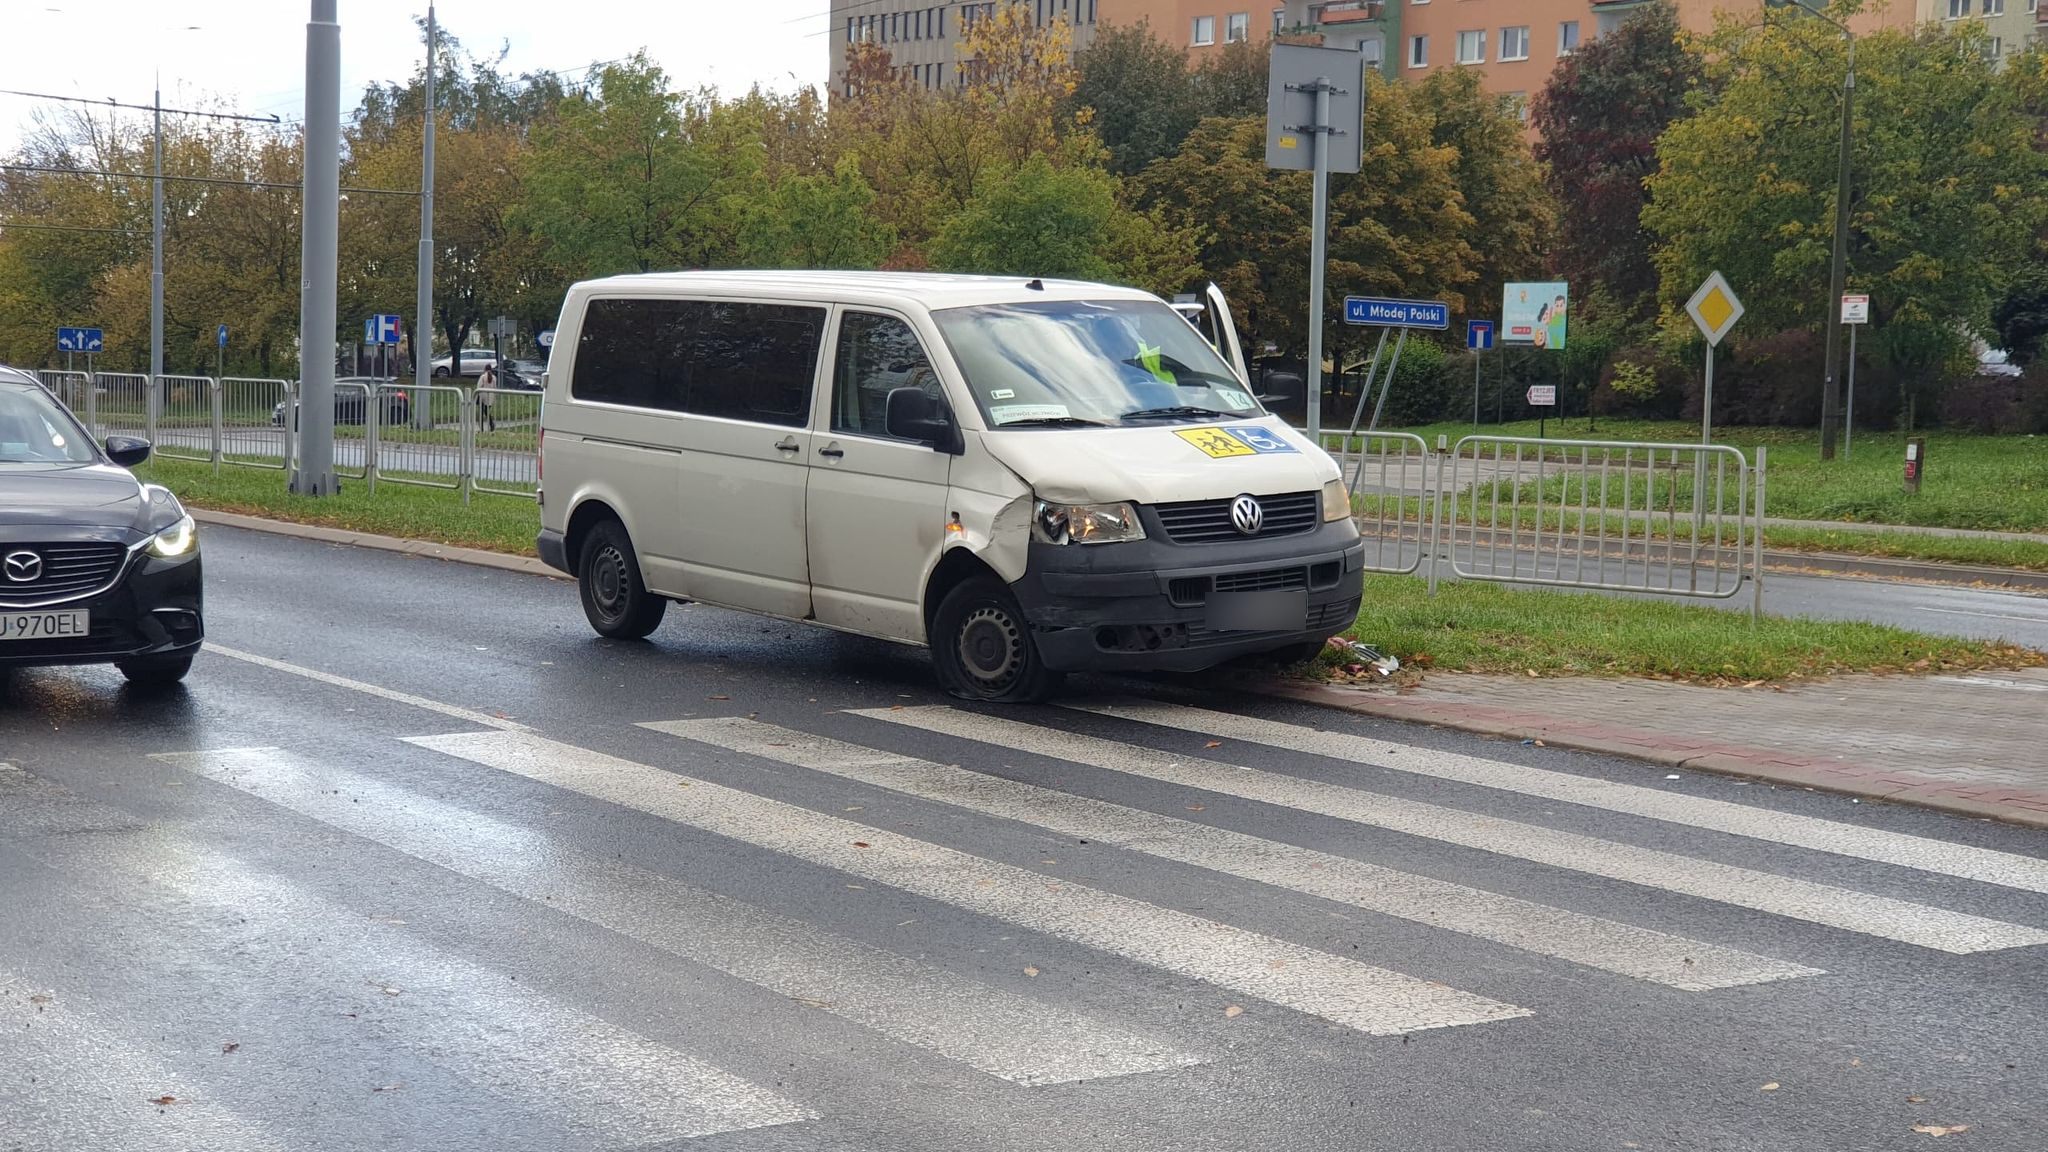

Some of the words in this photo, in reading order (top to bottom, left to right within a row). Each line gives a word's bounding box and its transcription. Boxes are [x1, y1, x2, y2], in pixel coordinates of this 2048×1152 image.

[1353, 304, 1365, 317] ul.
[1370, 305, 1406, 322] Młodej
[1410, 307, 1440, 321] Polski
[16, 614, 84, 637] 970EL
